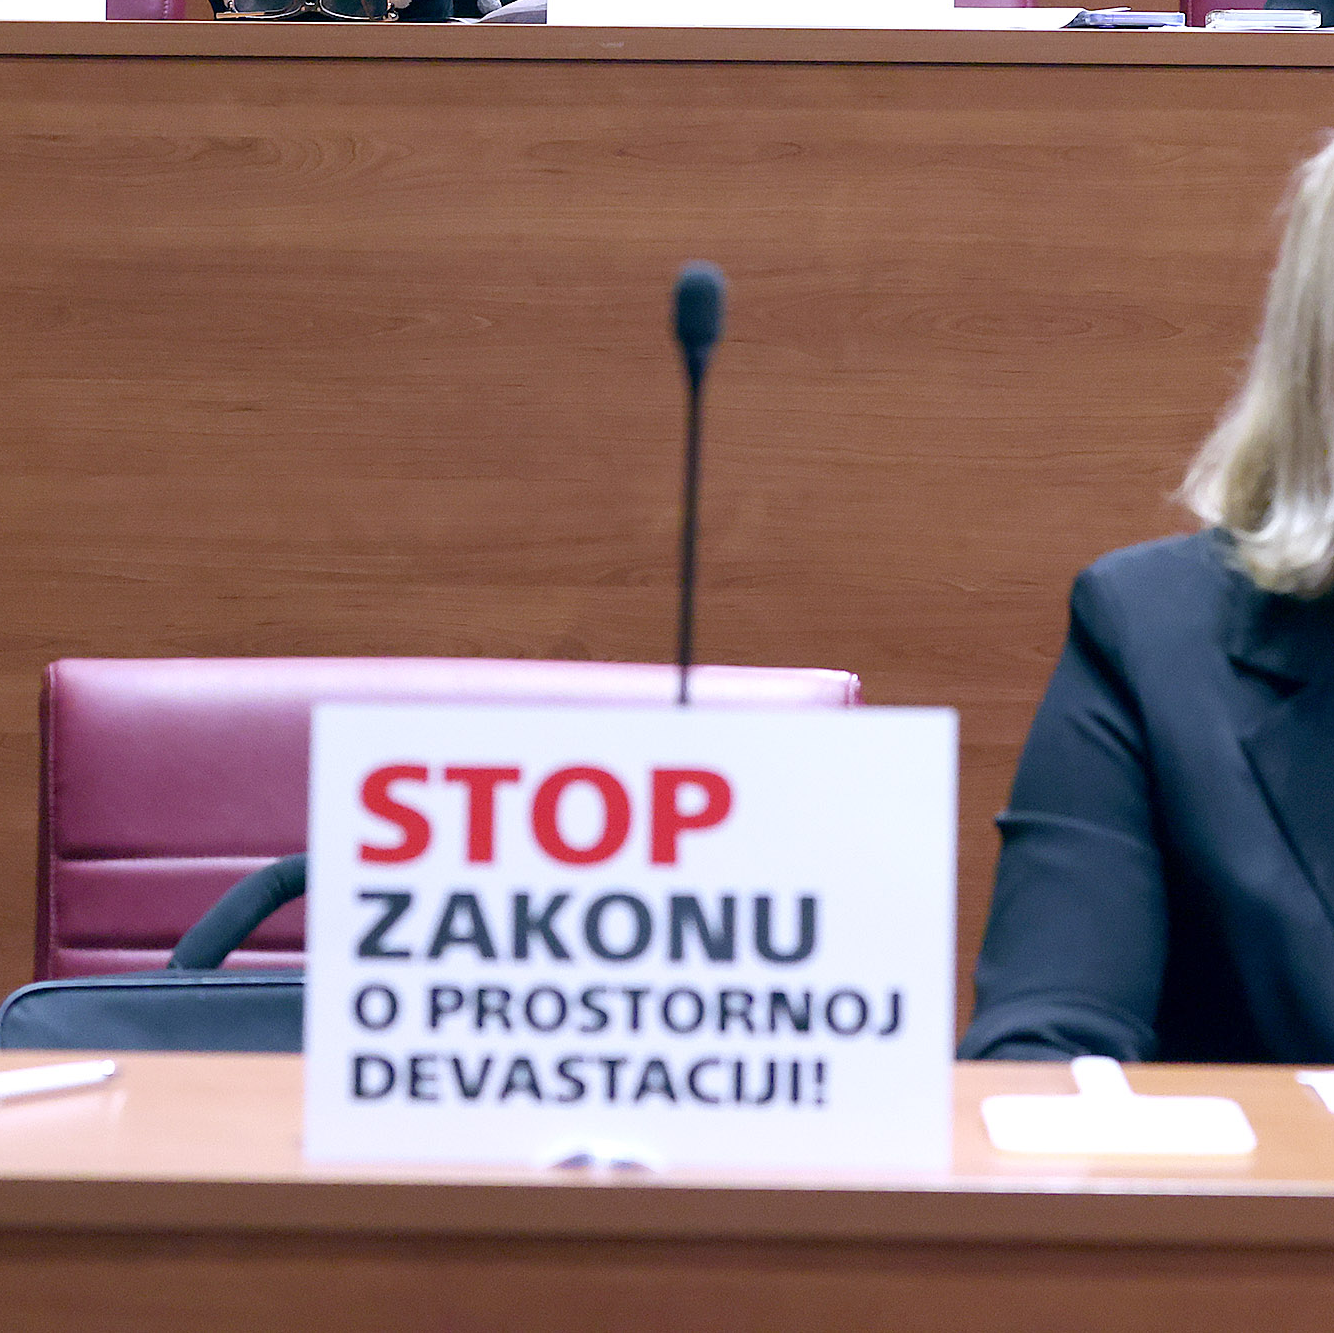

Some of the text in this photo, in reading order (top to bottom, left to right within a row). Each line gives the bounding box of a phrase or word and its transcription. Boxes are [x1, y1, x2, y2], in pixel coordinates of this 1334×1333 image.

[359, 764, 733, 867] STOP
[356, 891, 816, 964] ZAKONU
[354, 985, 901, 1035] O PROSTORNOJ
[352, 1055, 824, 1104] DEVASTACIJI!
